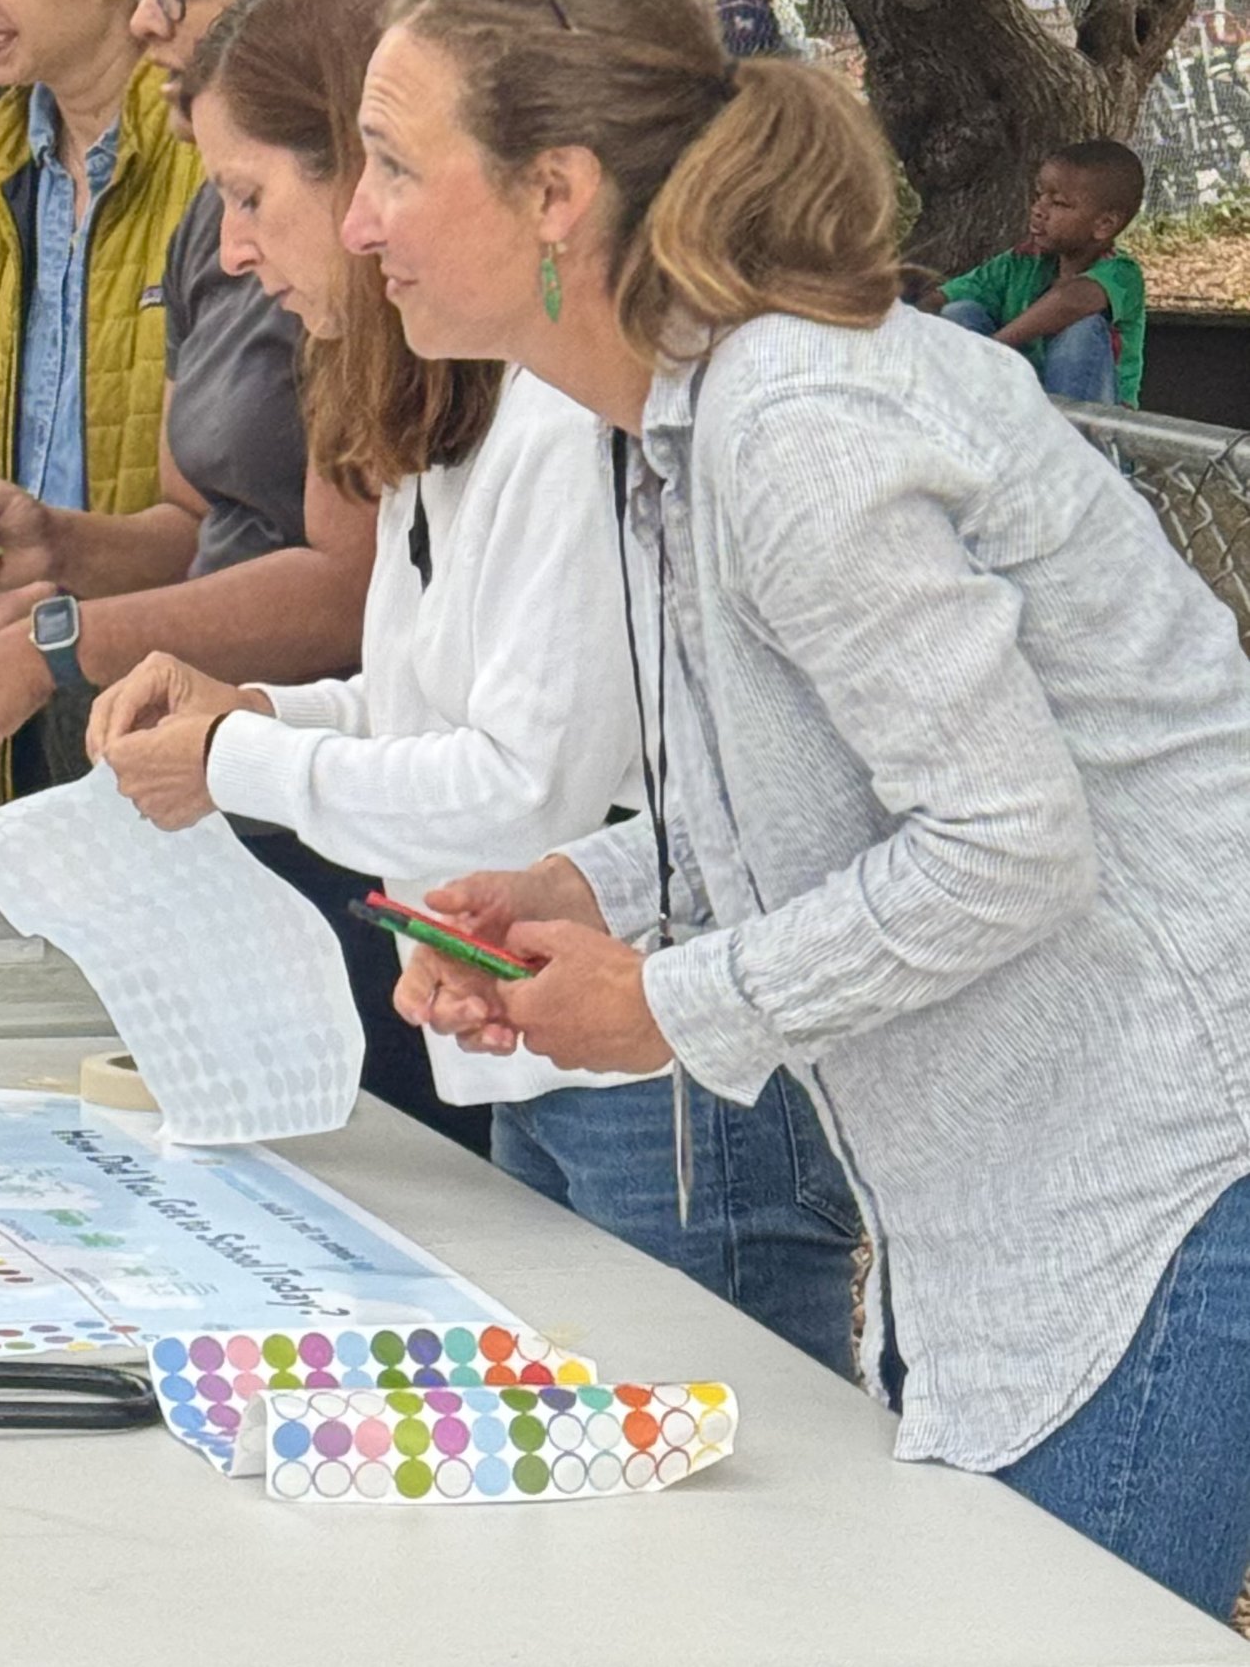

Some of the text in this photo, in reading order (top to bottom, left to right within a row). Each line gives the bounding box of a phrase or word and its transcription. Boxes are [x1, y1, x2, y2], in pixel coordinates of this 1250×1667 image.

[86, 1155, 151, 1175] Did
[148, 1199, 200, 1219] Get
[176, 1220, 212, 1232] to
[196, 1233, 288, 1269] School
[252, 1269, 351, 1317] Today?
